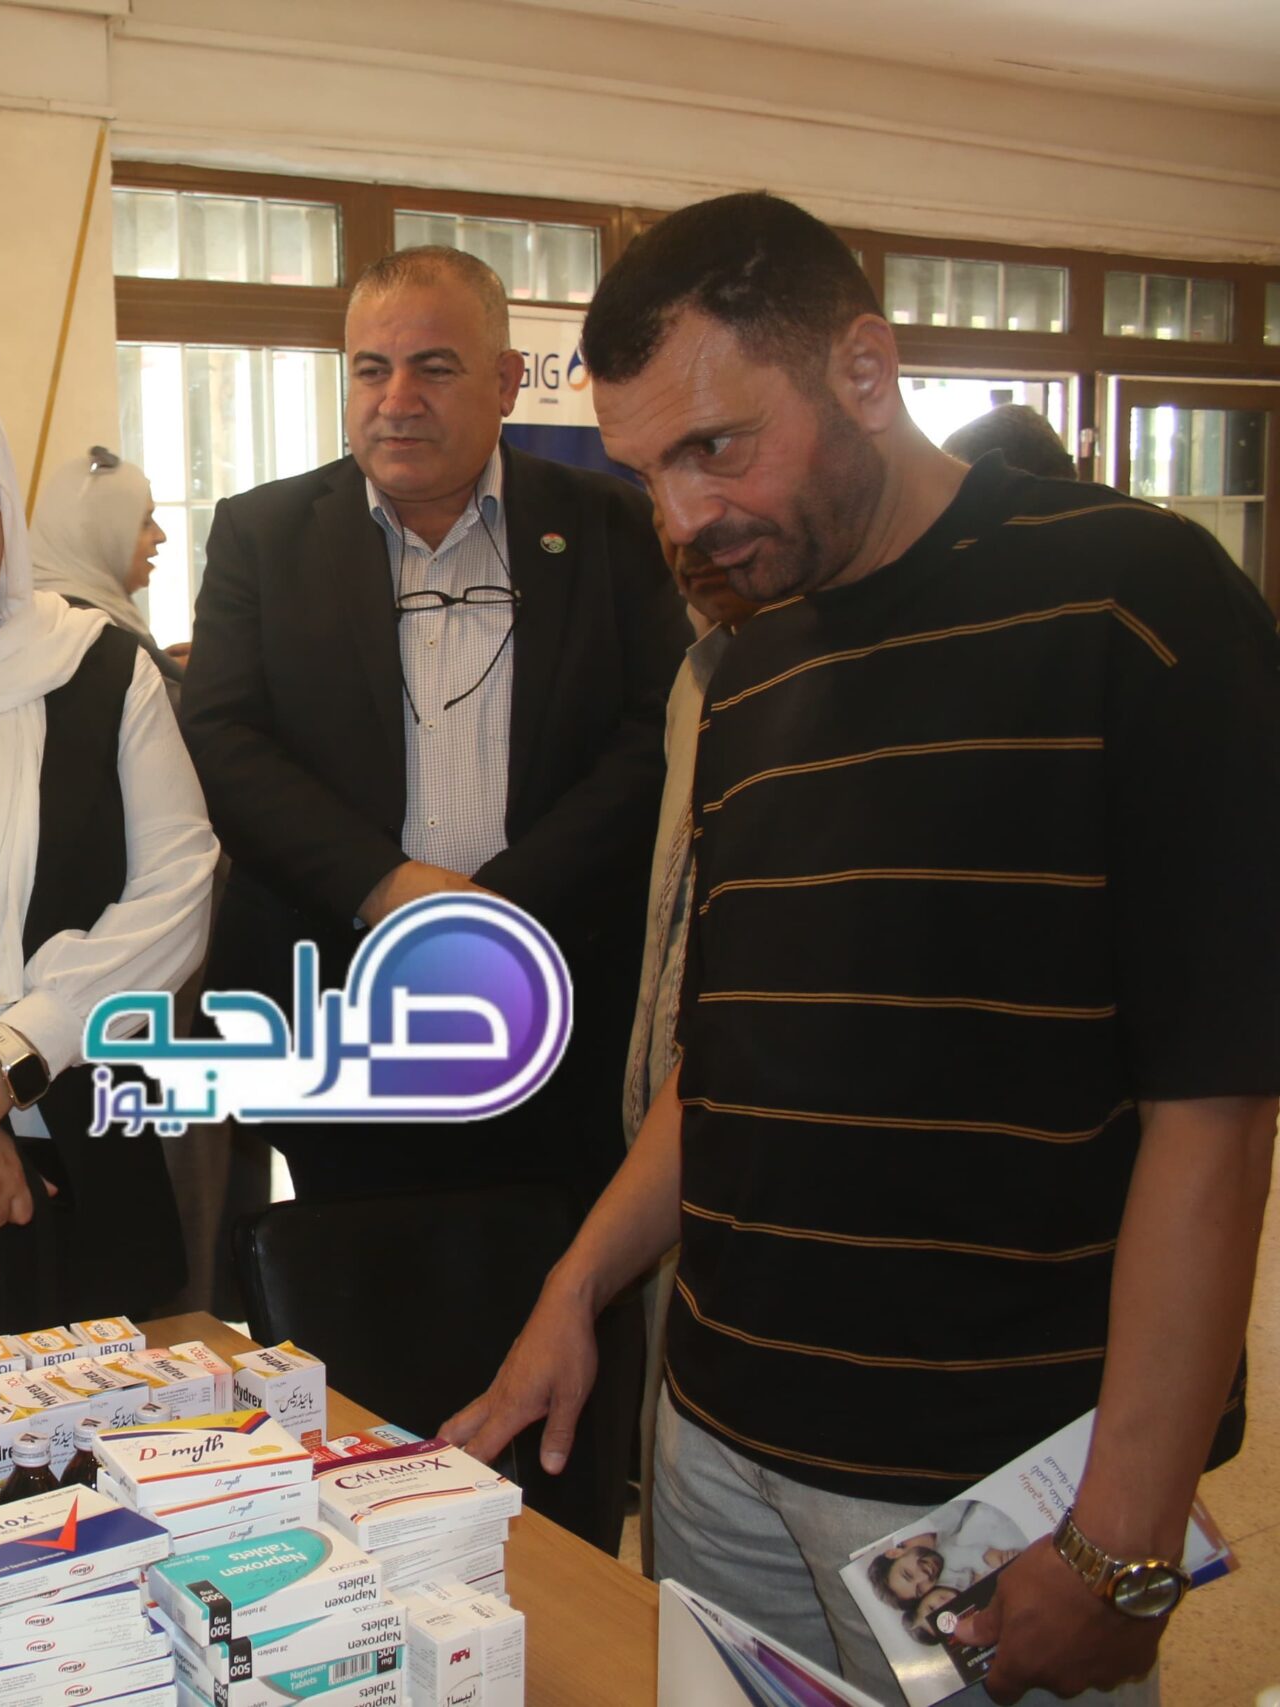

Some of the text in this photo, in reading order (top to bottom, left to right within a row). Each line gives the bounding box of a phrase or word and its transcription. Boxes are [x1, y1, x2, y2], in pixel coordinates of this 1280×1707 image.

[153, 1359, 190, 1380] Hydrex
[233, 1379, 263, 1409] Hydrex
[139, 1433, 225, 1463] D-myth
[334, 1457, 452, 1490] CALAMOX
[228, 1542, 296, 1561] Tablets
[219, 1551, 309, 1577] Naproxen
[338, 1573, 377, 1590] Tablets
[324, 1588, 377, 1609] Naproxen
[28, 1615, 52, 1626] mega
[213, 1616, 227, 1625] mg
[361, 1615, 401, 1632] Tablets
[210, 1623, 231, 1639] 500
[29, 1641, 52, 1652] mega
[347, 1630, 402, 1651] Naproxen
[60, 1661, 84, 1673] mega
[232, 1655, 247, 1665] mg
[380, 1656, 393, 1667] mg
[230, 1661, 251, 1677] 500
[289, 1664, 327, 1681] Naproxen
[66, 1685, 90, 1696] mega
[290, 1677, 318, 1692] Tablets
[359, 1680, 397, 1698] Tablets
